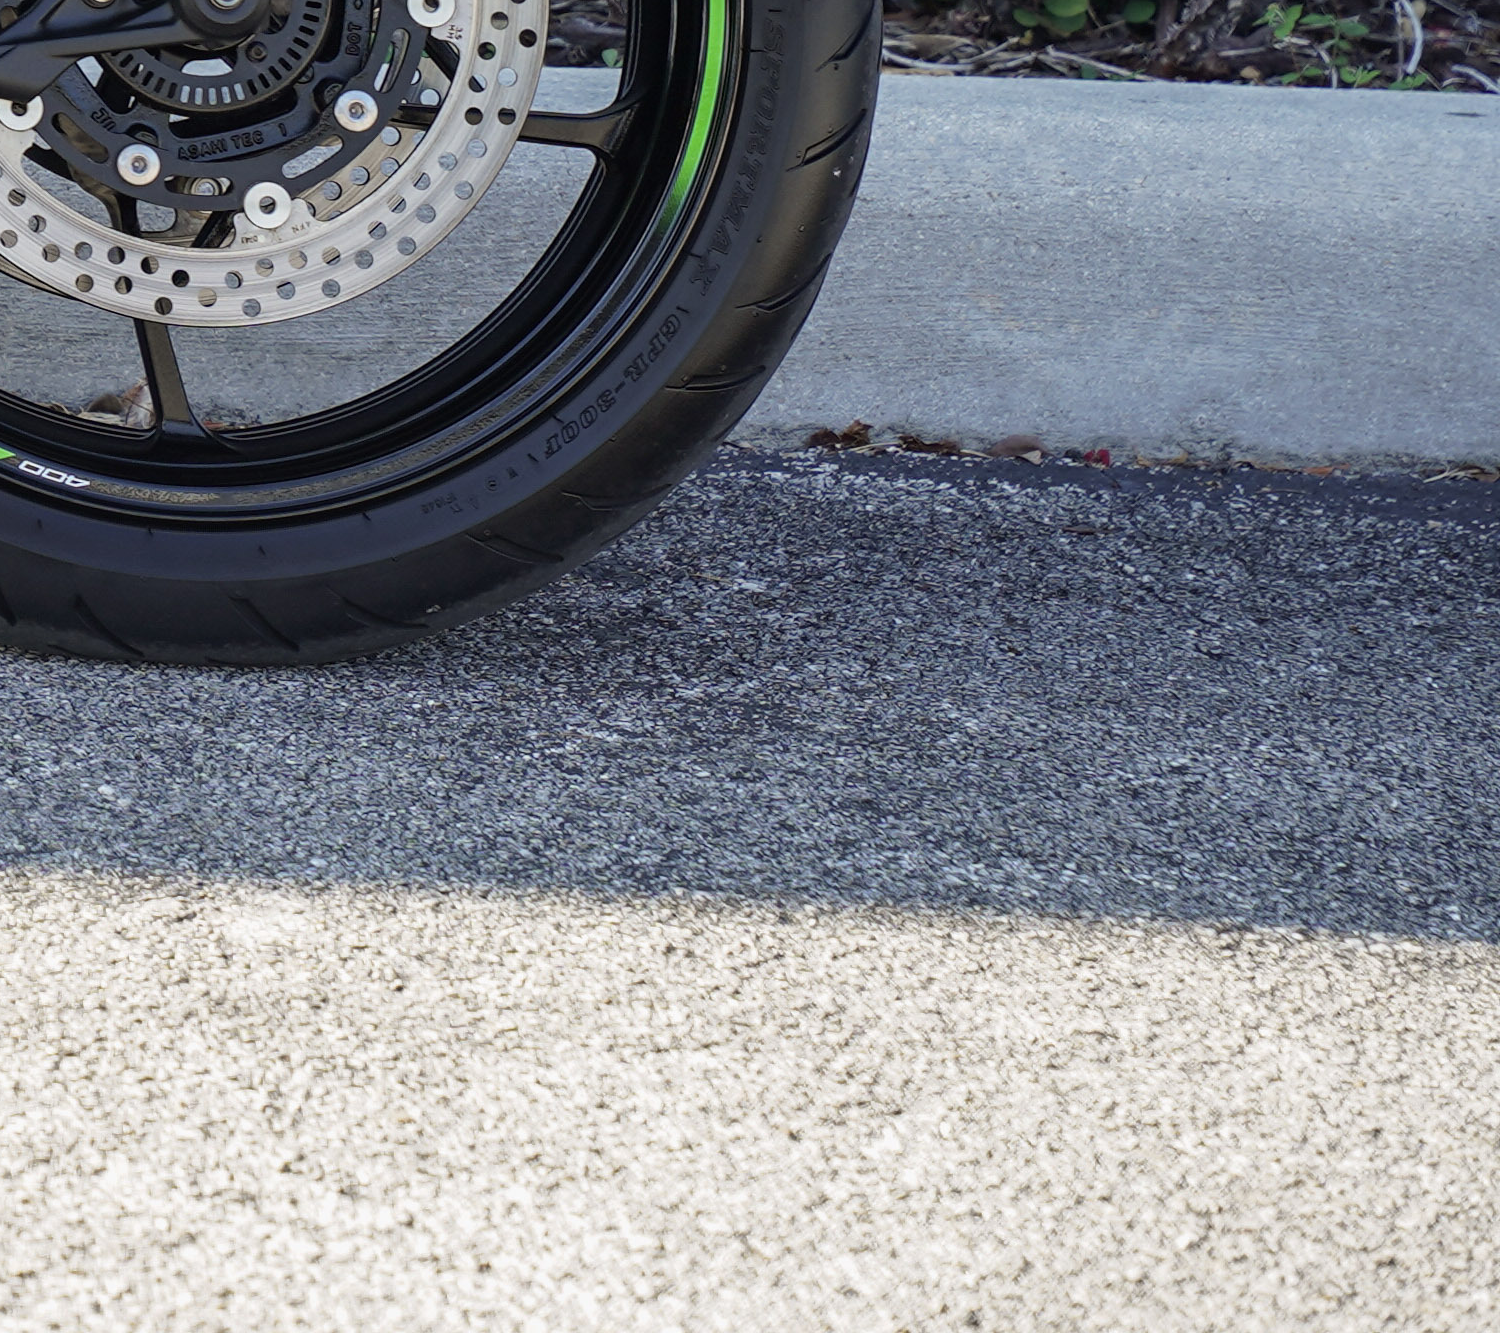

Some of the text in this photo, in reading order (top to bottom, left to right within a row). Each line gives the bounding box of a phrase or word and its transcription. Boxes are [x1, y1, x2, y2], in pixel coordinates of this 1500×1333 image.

[347, 22, 362, 56] DOT
[178, 137, 228, 161] ASAHI
[231, 129, 265, 149] TEC
[684, 17, 788, 297] SPORTMAX
[535, 311, 687, 460] GPR-300F
[18, 460, 90, 488] 400
